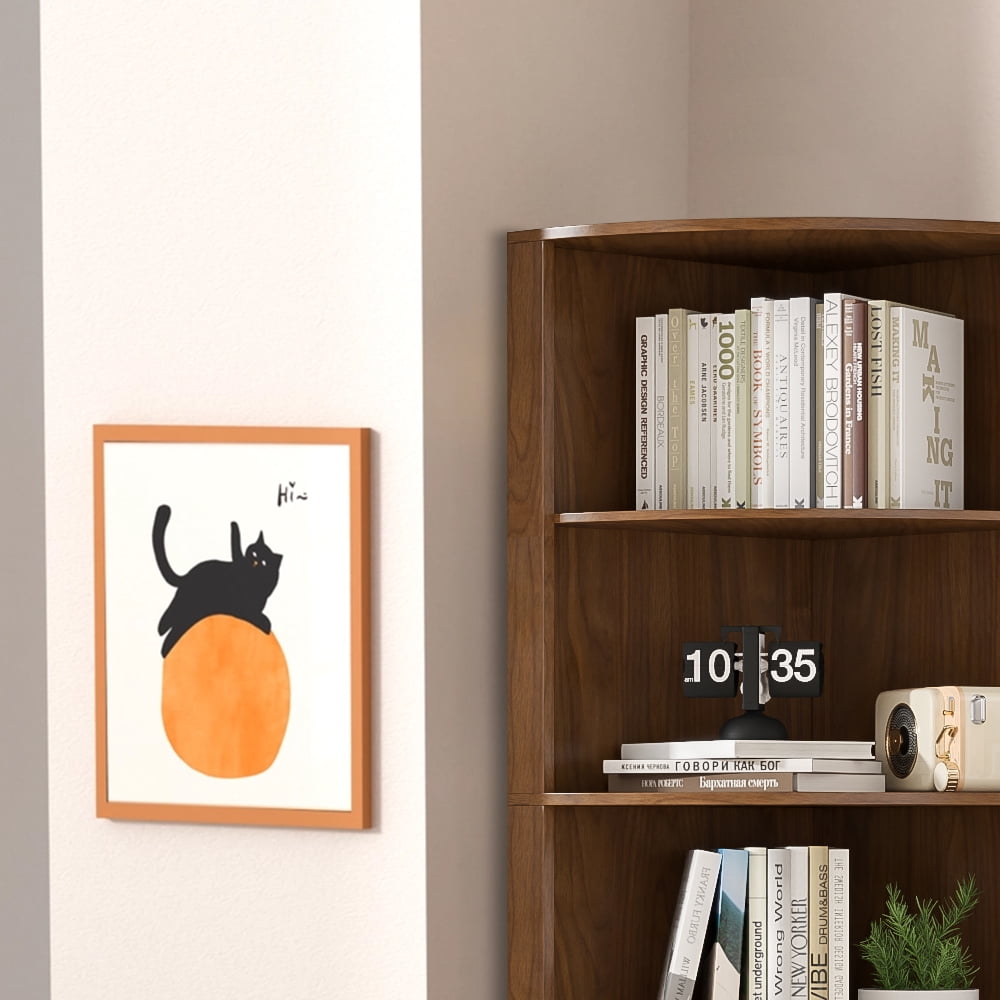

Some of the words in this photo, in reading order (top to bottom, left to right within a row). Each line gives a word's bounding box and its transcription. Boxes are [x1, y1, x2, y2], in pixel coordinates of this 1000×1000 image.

[719, 321, 735, 381] 1000
[825, 300, 839, 371] ALEXEY
[871, 307, 883, 352] LOST
[892, 316, 900, 367] MAKING
[640, 334, 649, 377] GRAPHIC
[753, 350, 763, 393] BOOK
[871, 358, 883, 397] FISH
[892, 371, 900, 384] IT
[640, 379, 649, 415] DESIGN
[778, 354, 788, 458] ANTIQUAIRES
[845, 363, 853, 406] Gardens
[657, 395, 665, 448] BORDEAUX
[845, 408, 853, 417] in
[640, 417, 649, 480] REFERENCED
[753, 409, 763, 486] SYMBOLS
[825, 378, 839, 498] BRODOVITCH
[845, 420, 853, 455] France
[934, 479, 953, 509] IT
[686, 648, 731, 683] 10
[769, 648, 817, 683] 35
[675, 760, 729, 771] ГОВОРИ
[734, 760, 755, 771] КАК
[760, 760, 781, 771] БОГ
[699, 776, 747, 791] Бархатная
[748, 778, 779, 791] смерть
[774, 863, 785, 923] World
[818, 864, 828, 945] DRUM&BASS
[791, 898, 807, 959] YORKER
[752, 921, 763, 990] underground
[774, 930, 785, 996] Wrong
[791, 963, 807, 998] NEW
